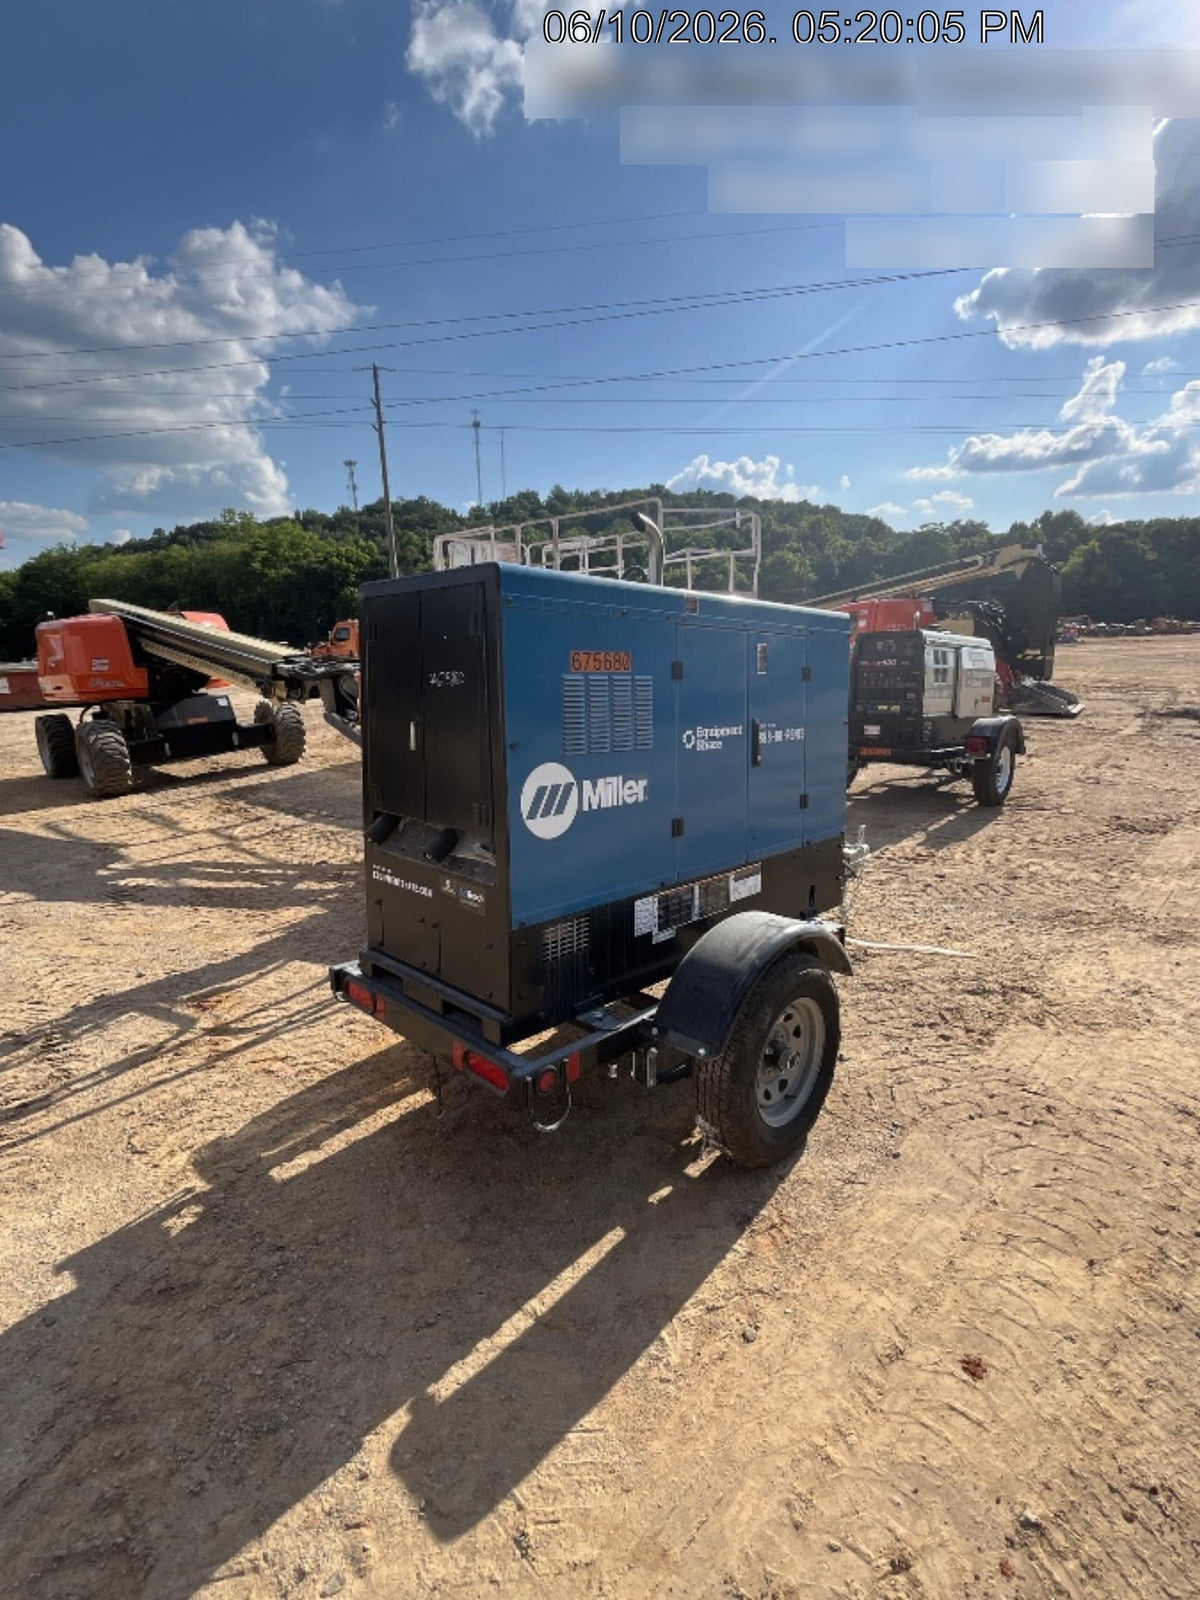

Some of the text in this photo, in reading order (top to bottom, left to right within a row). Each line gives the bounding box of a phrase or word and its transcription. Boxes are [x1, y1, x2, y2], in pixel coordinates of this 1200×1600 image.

[572, 652, 630, 671] 675680
[696, 725, 742, 739] Equipment
[582, 775, 648, 811] Miller
